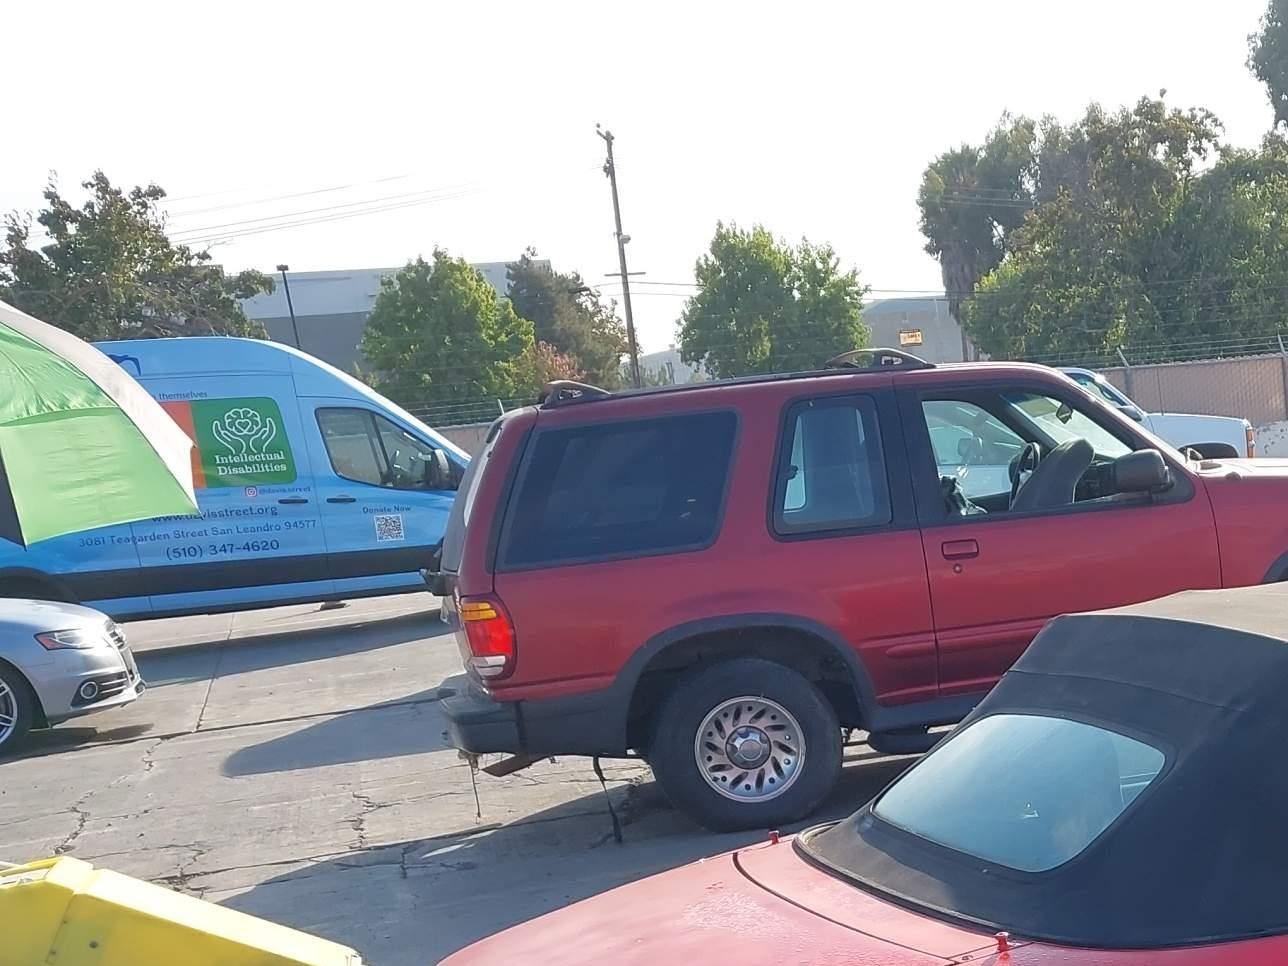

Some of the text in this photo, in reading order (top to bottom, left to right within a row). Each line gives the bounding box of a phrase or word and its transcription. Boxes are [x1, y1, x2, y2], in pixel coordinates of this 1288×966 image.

[158, 391, 208, 400] themselves
[214, 450, 286, 464] Intellectual
[217, 463, 287, 476] Disabilities
[79, 519, 317, 547] 3081 Teagarden Street San Leandro 94577
[165, 538, 280, 561] (510) 347-4620
